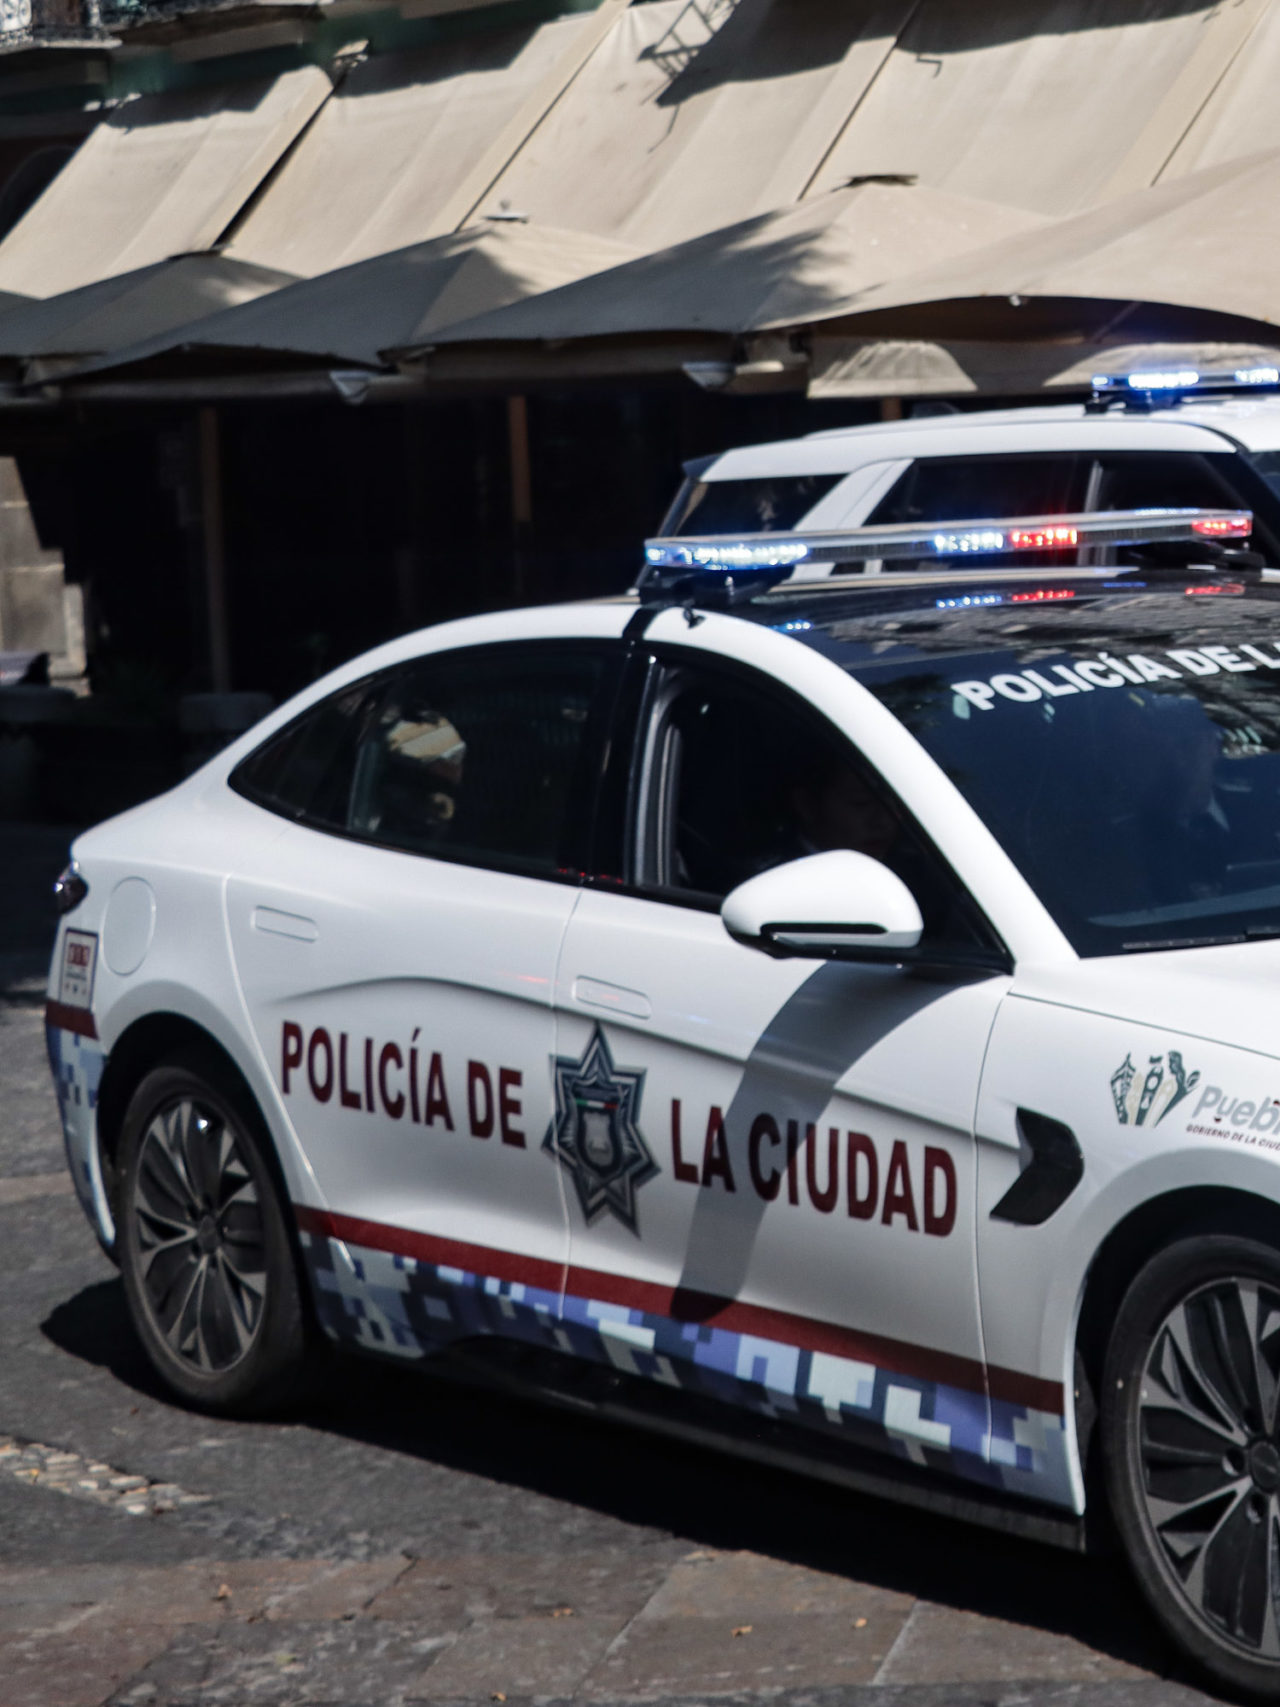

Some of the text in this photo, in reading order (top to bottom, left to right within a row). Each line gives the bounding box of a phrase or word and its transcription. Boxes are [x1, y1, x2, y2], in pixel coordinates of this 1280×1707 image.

[951, 651, 1183, 711] POLICÍA
[1164, 645, 1257, 676] DE
[281, 1021, 959, 1239] POLICÍA DE LA CIUDAD
[1185, 1124, 1231, 1140] GOBIERNO
[1231, 1132, 1245, 1143] DE
[1244, 1135, 1257, 1145] LA
